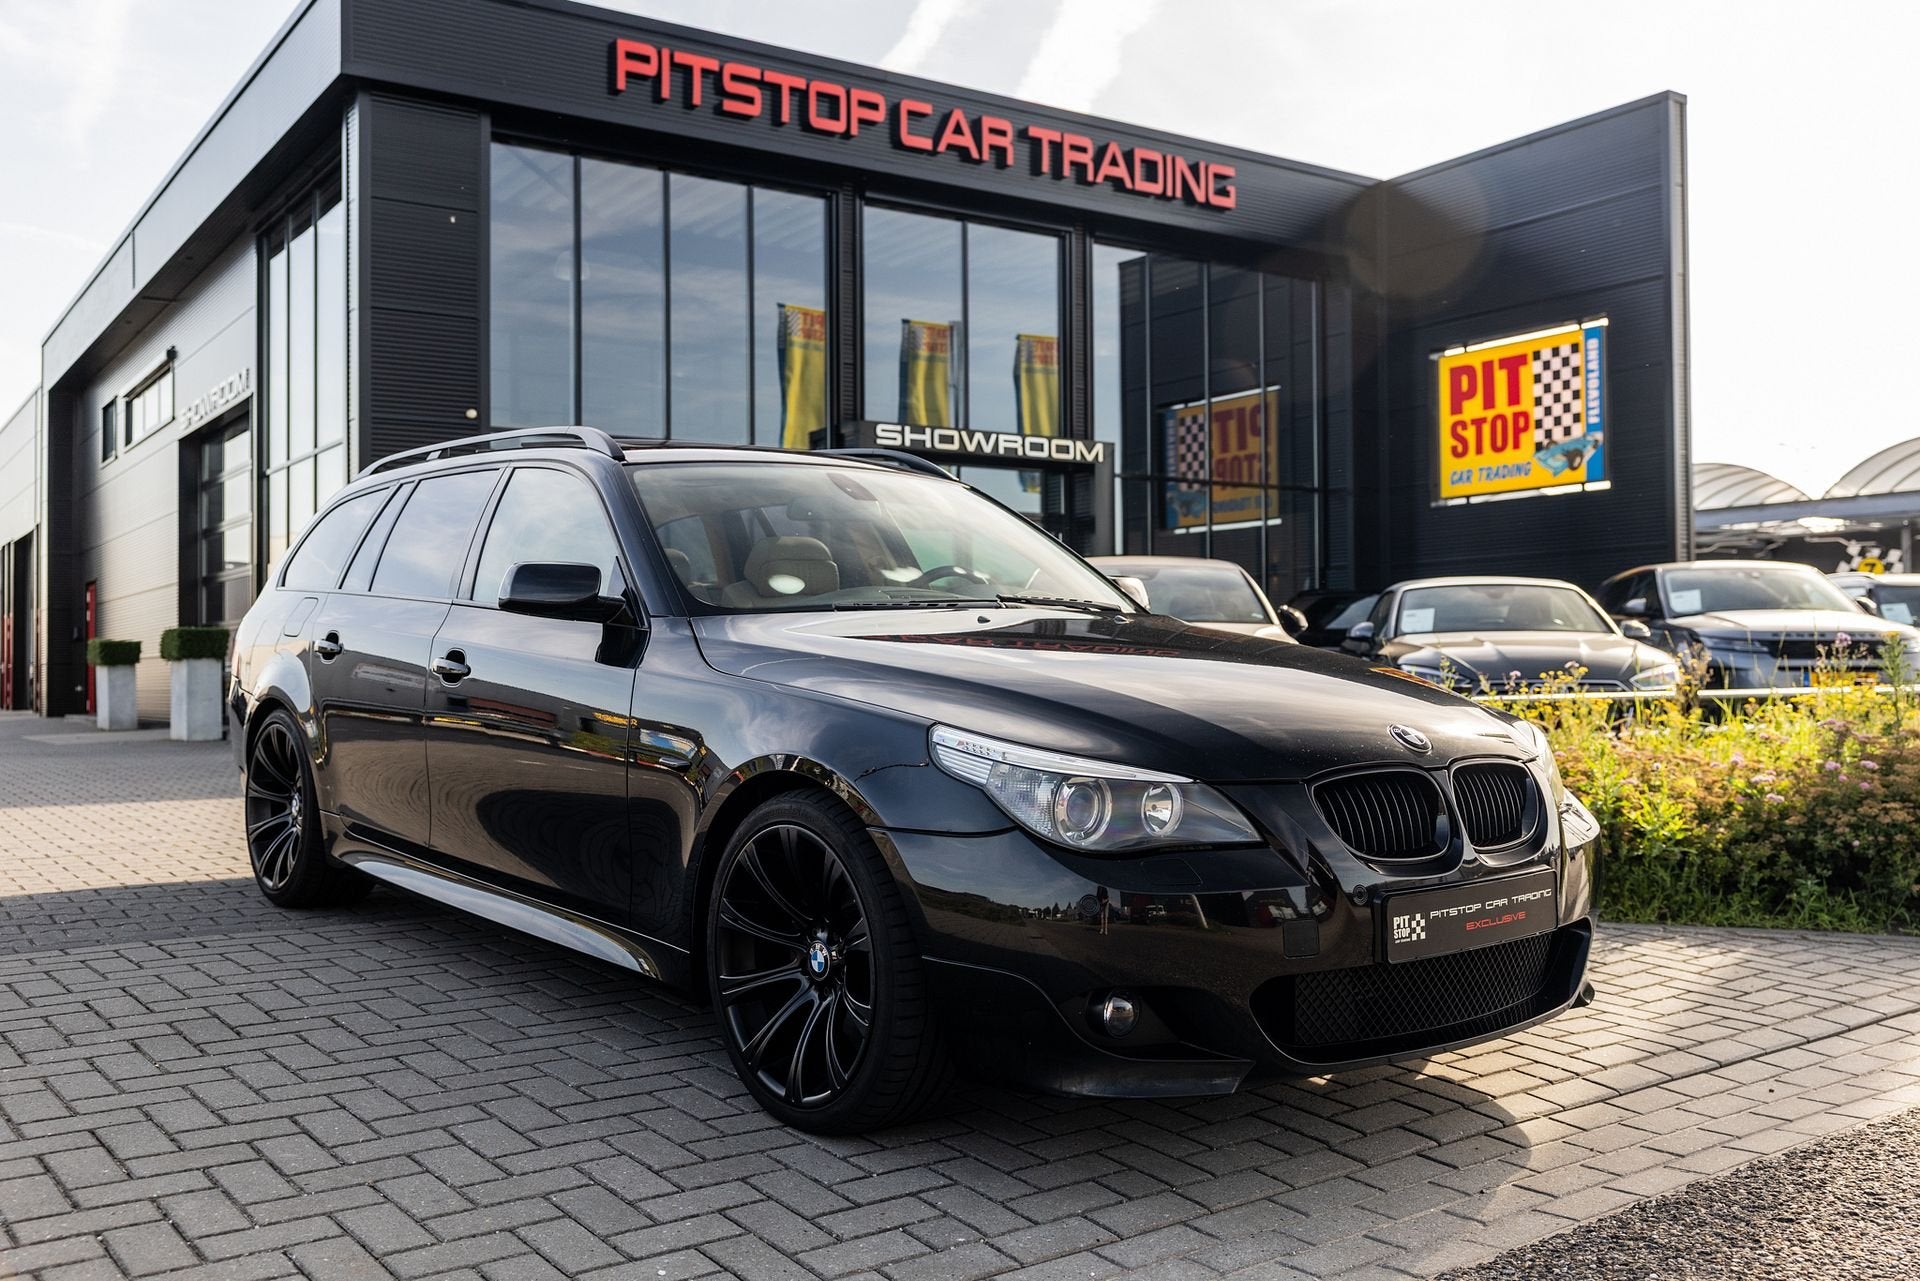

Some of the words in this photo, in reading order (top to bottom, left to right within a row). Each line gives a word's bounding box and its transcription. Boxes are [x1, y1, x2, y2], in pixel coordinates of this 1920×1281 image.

[616, 38, 886, 136] PITSTOP
[900, 99, 1014, 166] CAR
[1028, 126, 1236, 209] TRADING
[1450, 354, 1528, 416] PIT
[875, 423, 1104, 463] SHOWROOM
[1451, 411, 1530, 458] STOP
[1450, 469, 1473, 485] CAR
[1478, 461, 1531, 483] TRADING
[1430, 903, 1482, 919] PITSTOP
[1485, 898, 1508, 910] CAR
[1465, 911, 1526, 930] EXCLUSIVE
[1393, 915, 1410, 930] PIT
[1393, 927, 1410, 939] STOP
